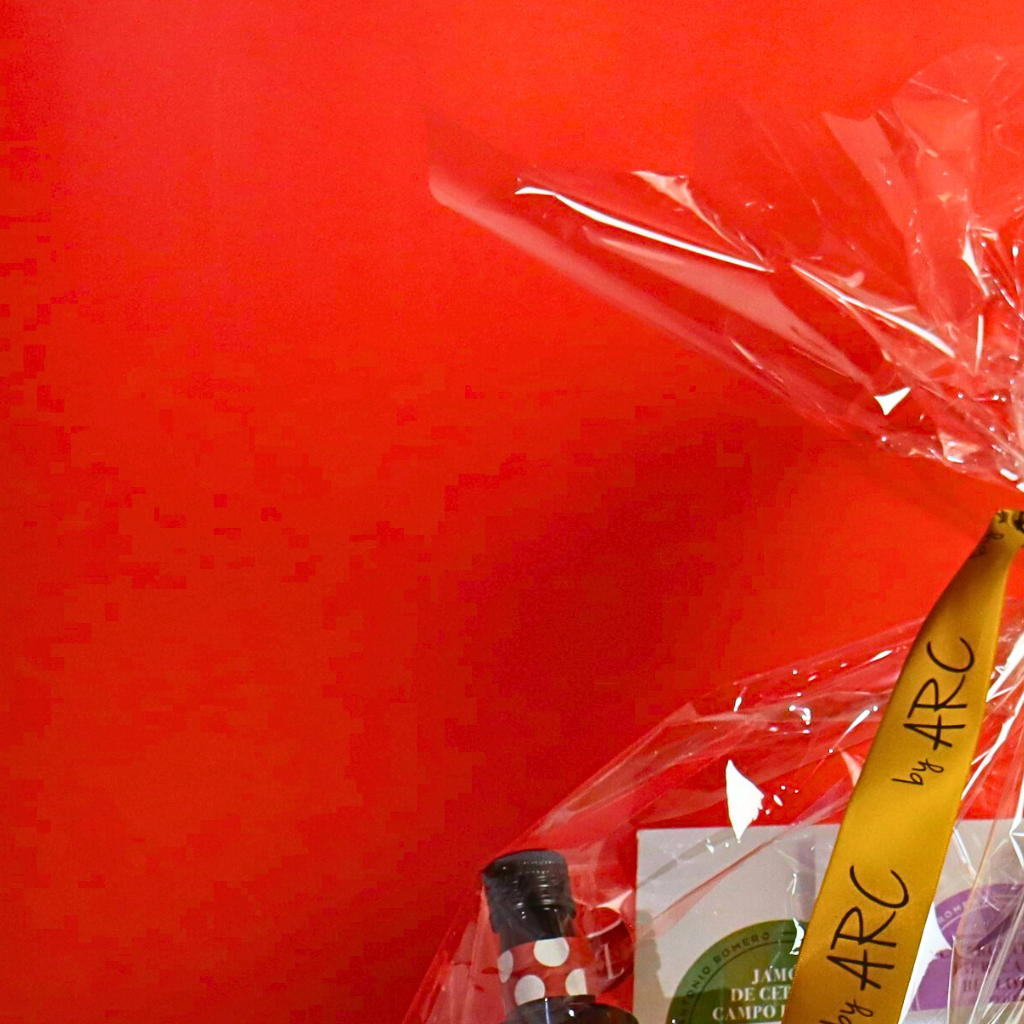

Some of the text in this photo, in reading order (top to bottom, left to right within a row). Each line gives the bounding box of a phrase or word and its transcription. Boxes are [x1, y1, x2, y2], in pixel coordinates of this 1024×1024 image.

[891, 637, 975, 785] by ARC
[826, 865, 909, 991] ARC
[713, 931, 771, 963] ROMERO
[730, 987, 755, 1003] DE
[712, 1004, 776, 1021] CAMPO
